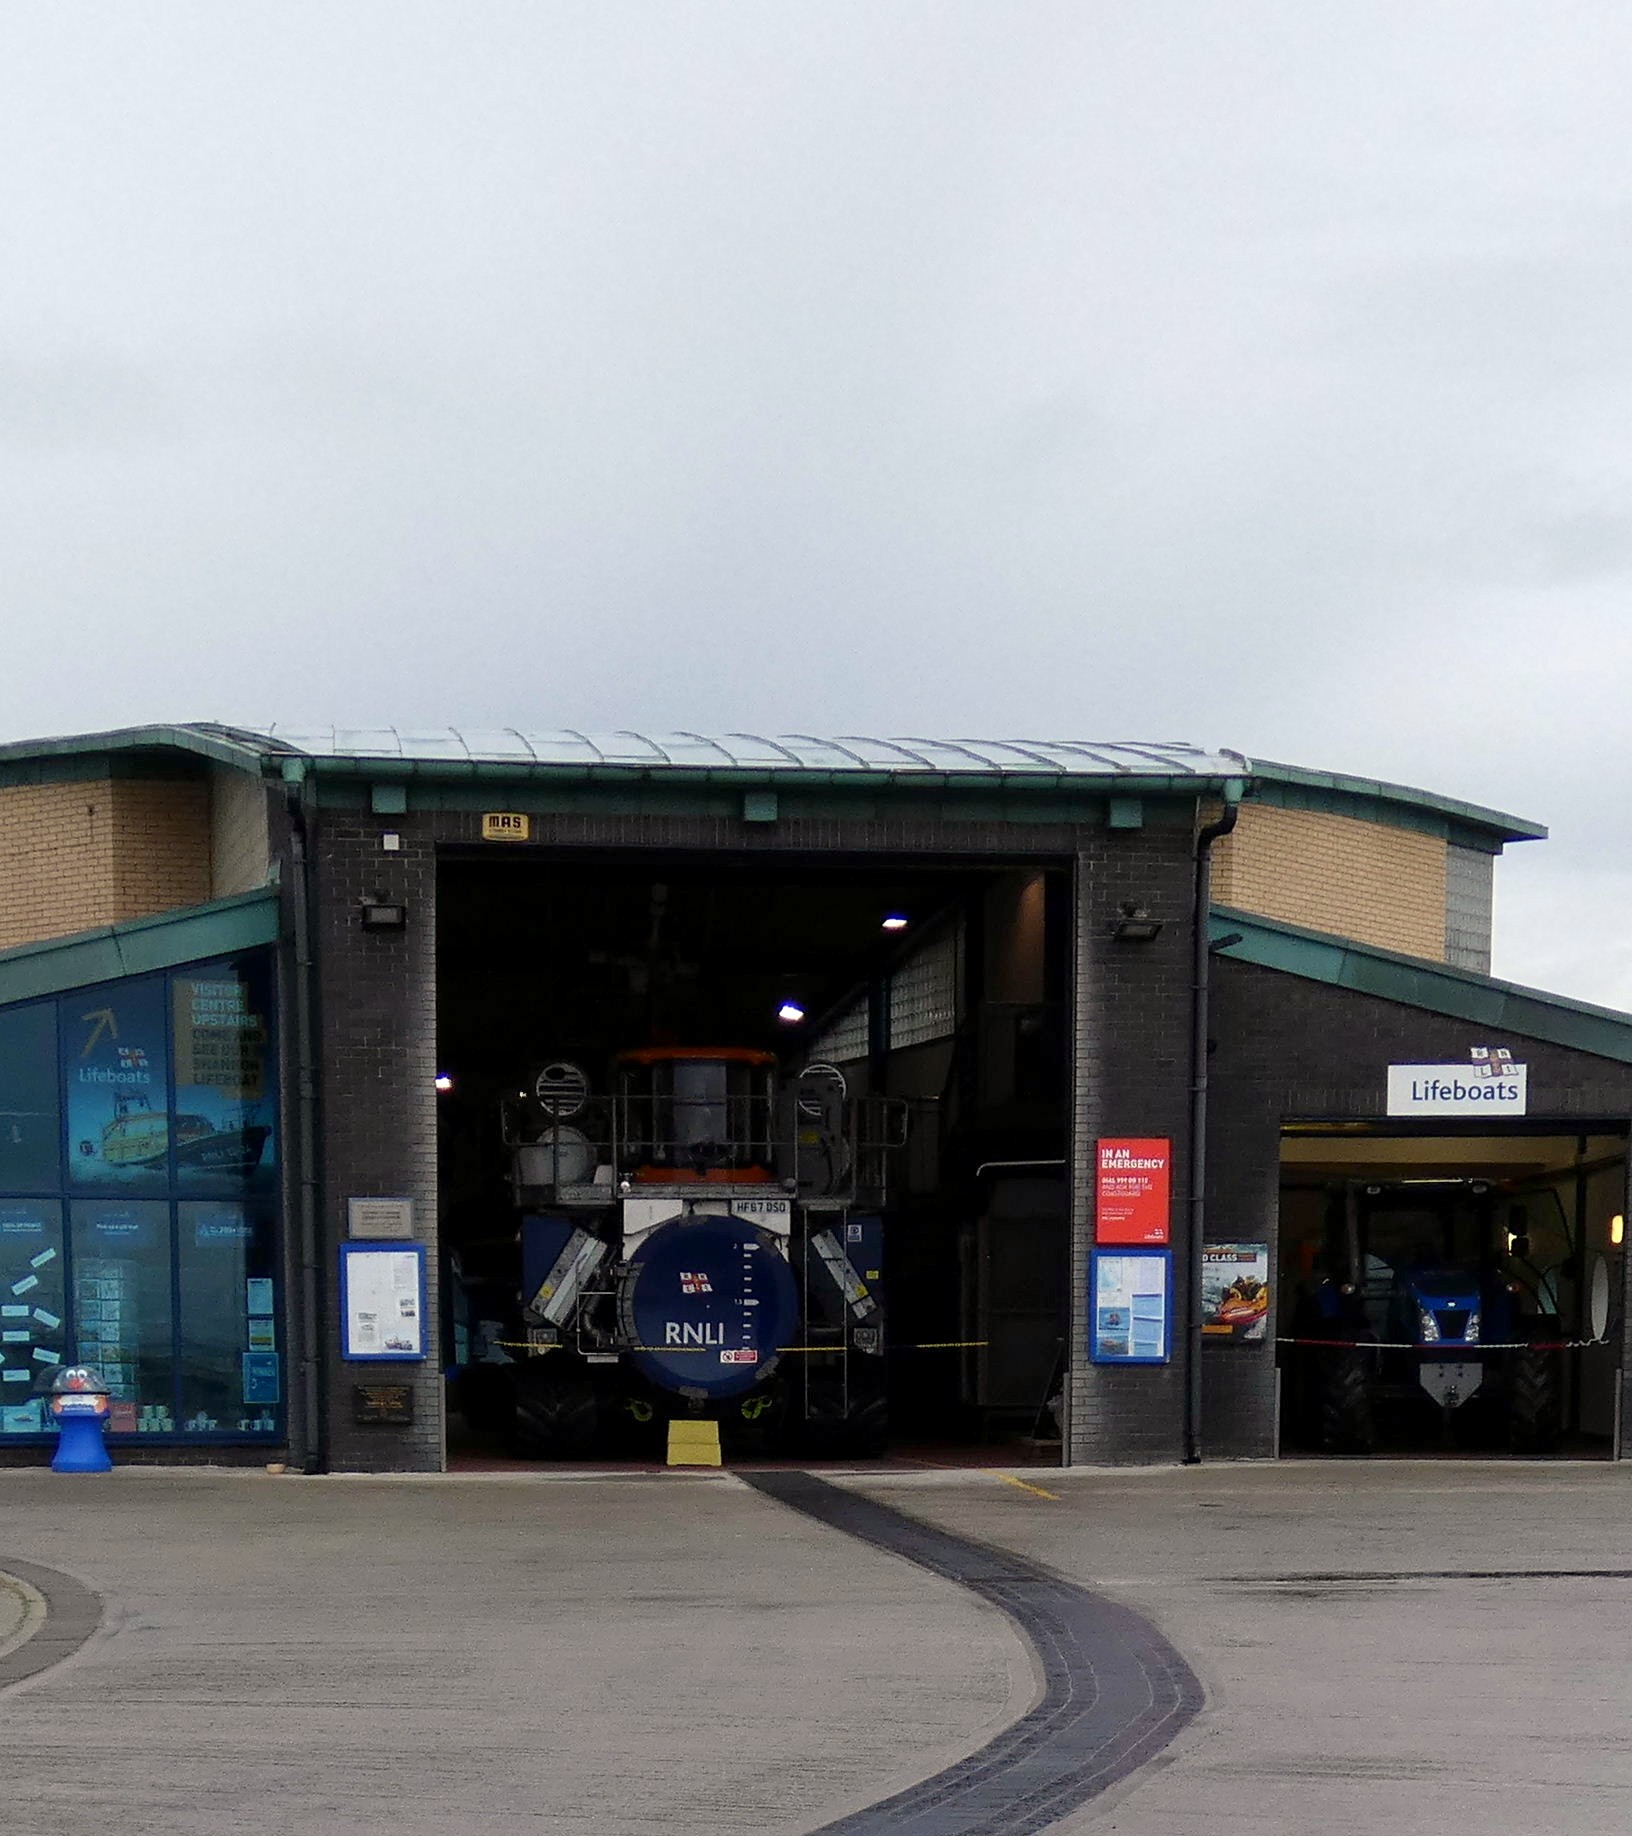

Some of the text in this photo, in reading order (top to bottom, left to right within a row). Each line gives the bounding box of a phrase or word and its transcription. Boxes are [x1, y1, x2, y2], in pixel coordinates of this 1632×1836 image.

[489, 815, 521, 829] MAS
[191, 1013, 258, 1027] UPSTAIRS
[79, 1067, 151, 1084] Lifeboats
[1412, 1080, 1518, 1101] Lifeboats
[1101, 1149, 1130, 1159] IN AN
[1101, 1159, 1164, 1169] EMERGENCY
[1210, 1253, 1238, 1262] CLASS
[665, 1322, 724, 1345] RNLI
